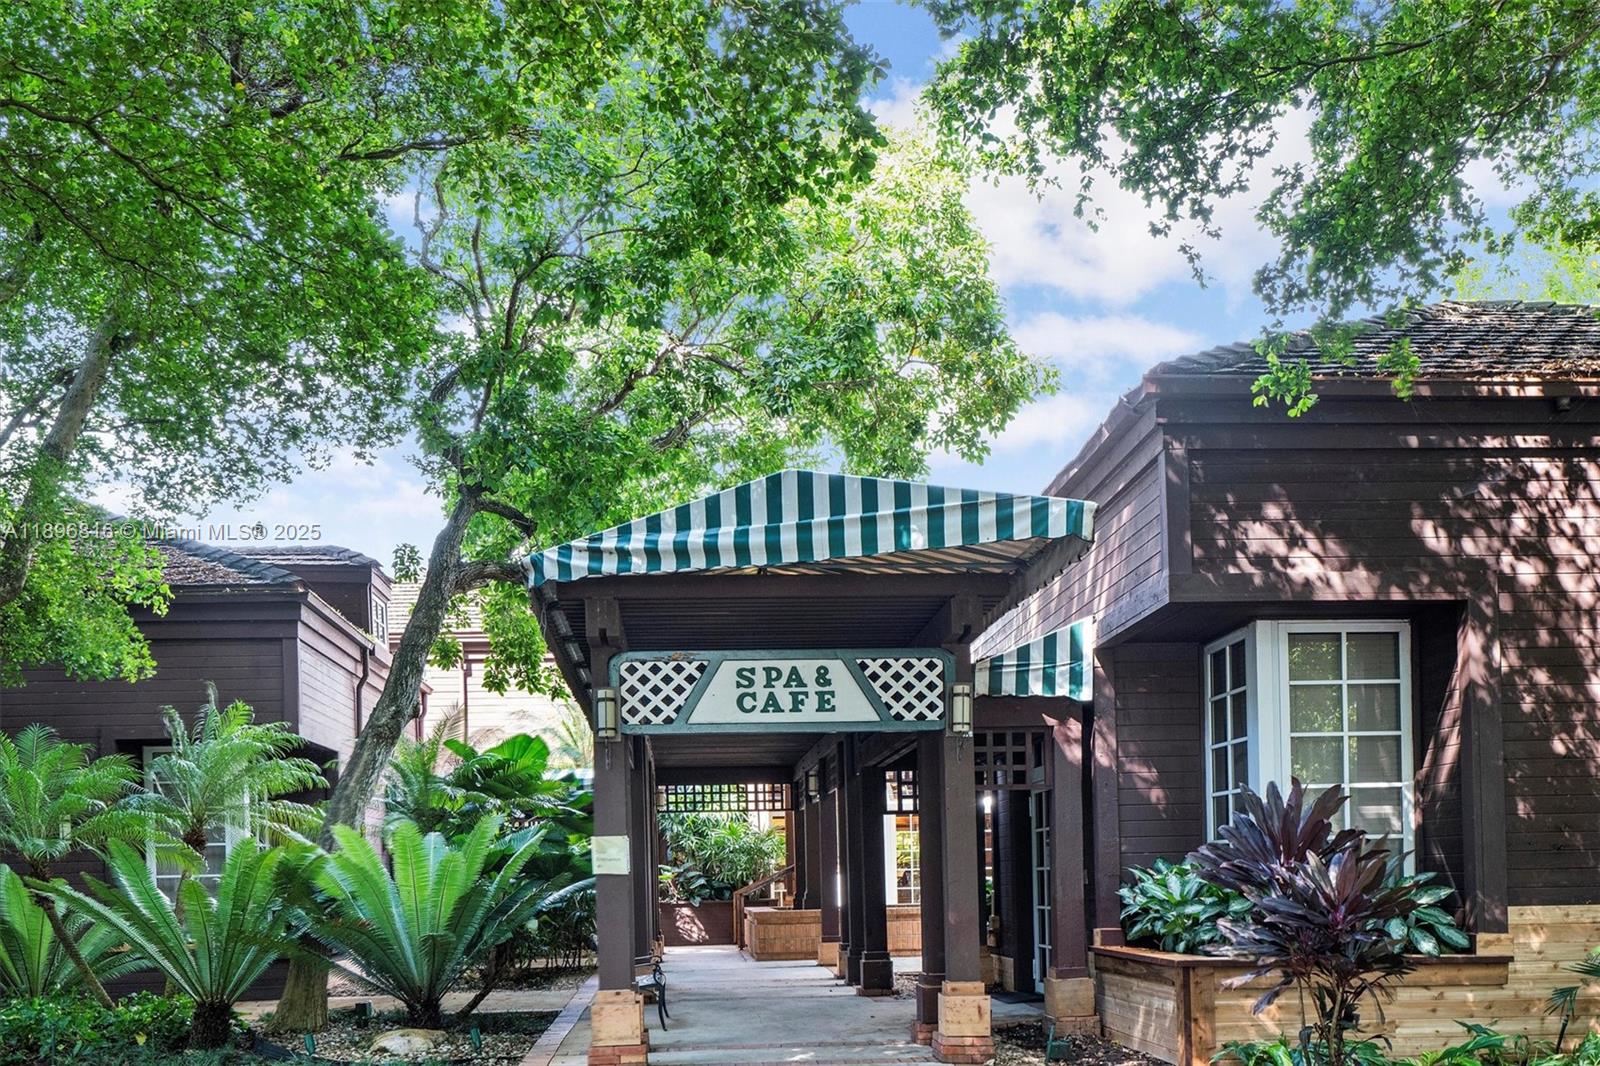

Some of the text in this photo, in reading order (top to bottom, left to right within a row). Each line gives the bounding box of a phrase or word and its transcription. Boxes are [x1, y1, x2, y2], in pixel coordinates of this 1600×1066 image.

[736, 665, 832, 688] SPA &
[736, 690, 836, 713] CAFE
